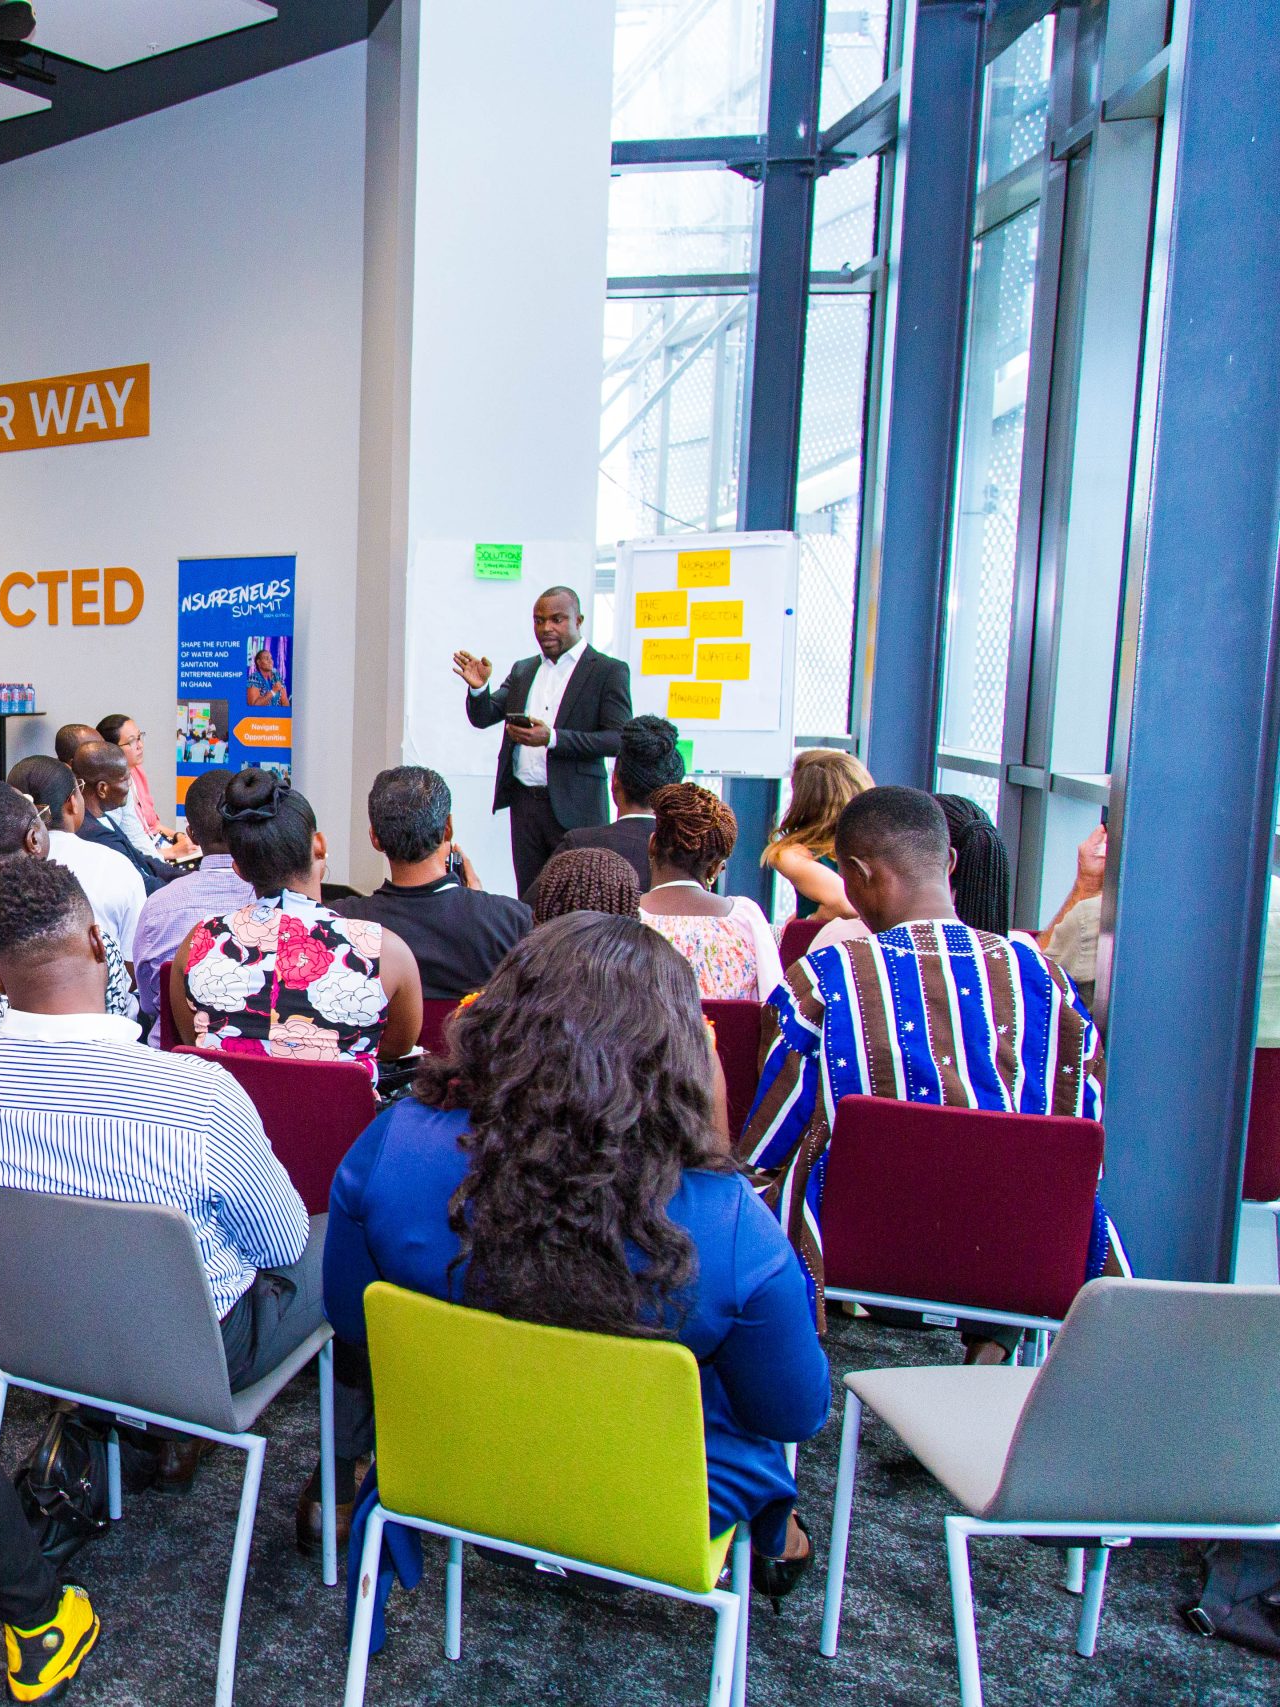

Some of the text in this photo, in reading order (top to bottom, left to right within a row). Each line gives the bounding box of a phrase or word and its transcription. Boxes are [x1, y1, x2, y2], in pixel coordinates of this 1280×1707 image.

[29, 377, 136, 437] WAY
[232, 598, 283, 618] SUMMIT
[692, 609, 738, 621] SECTOR
[251, 723, 279, 732] Navigate
[244, 733, 287, 742] Opportunities
